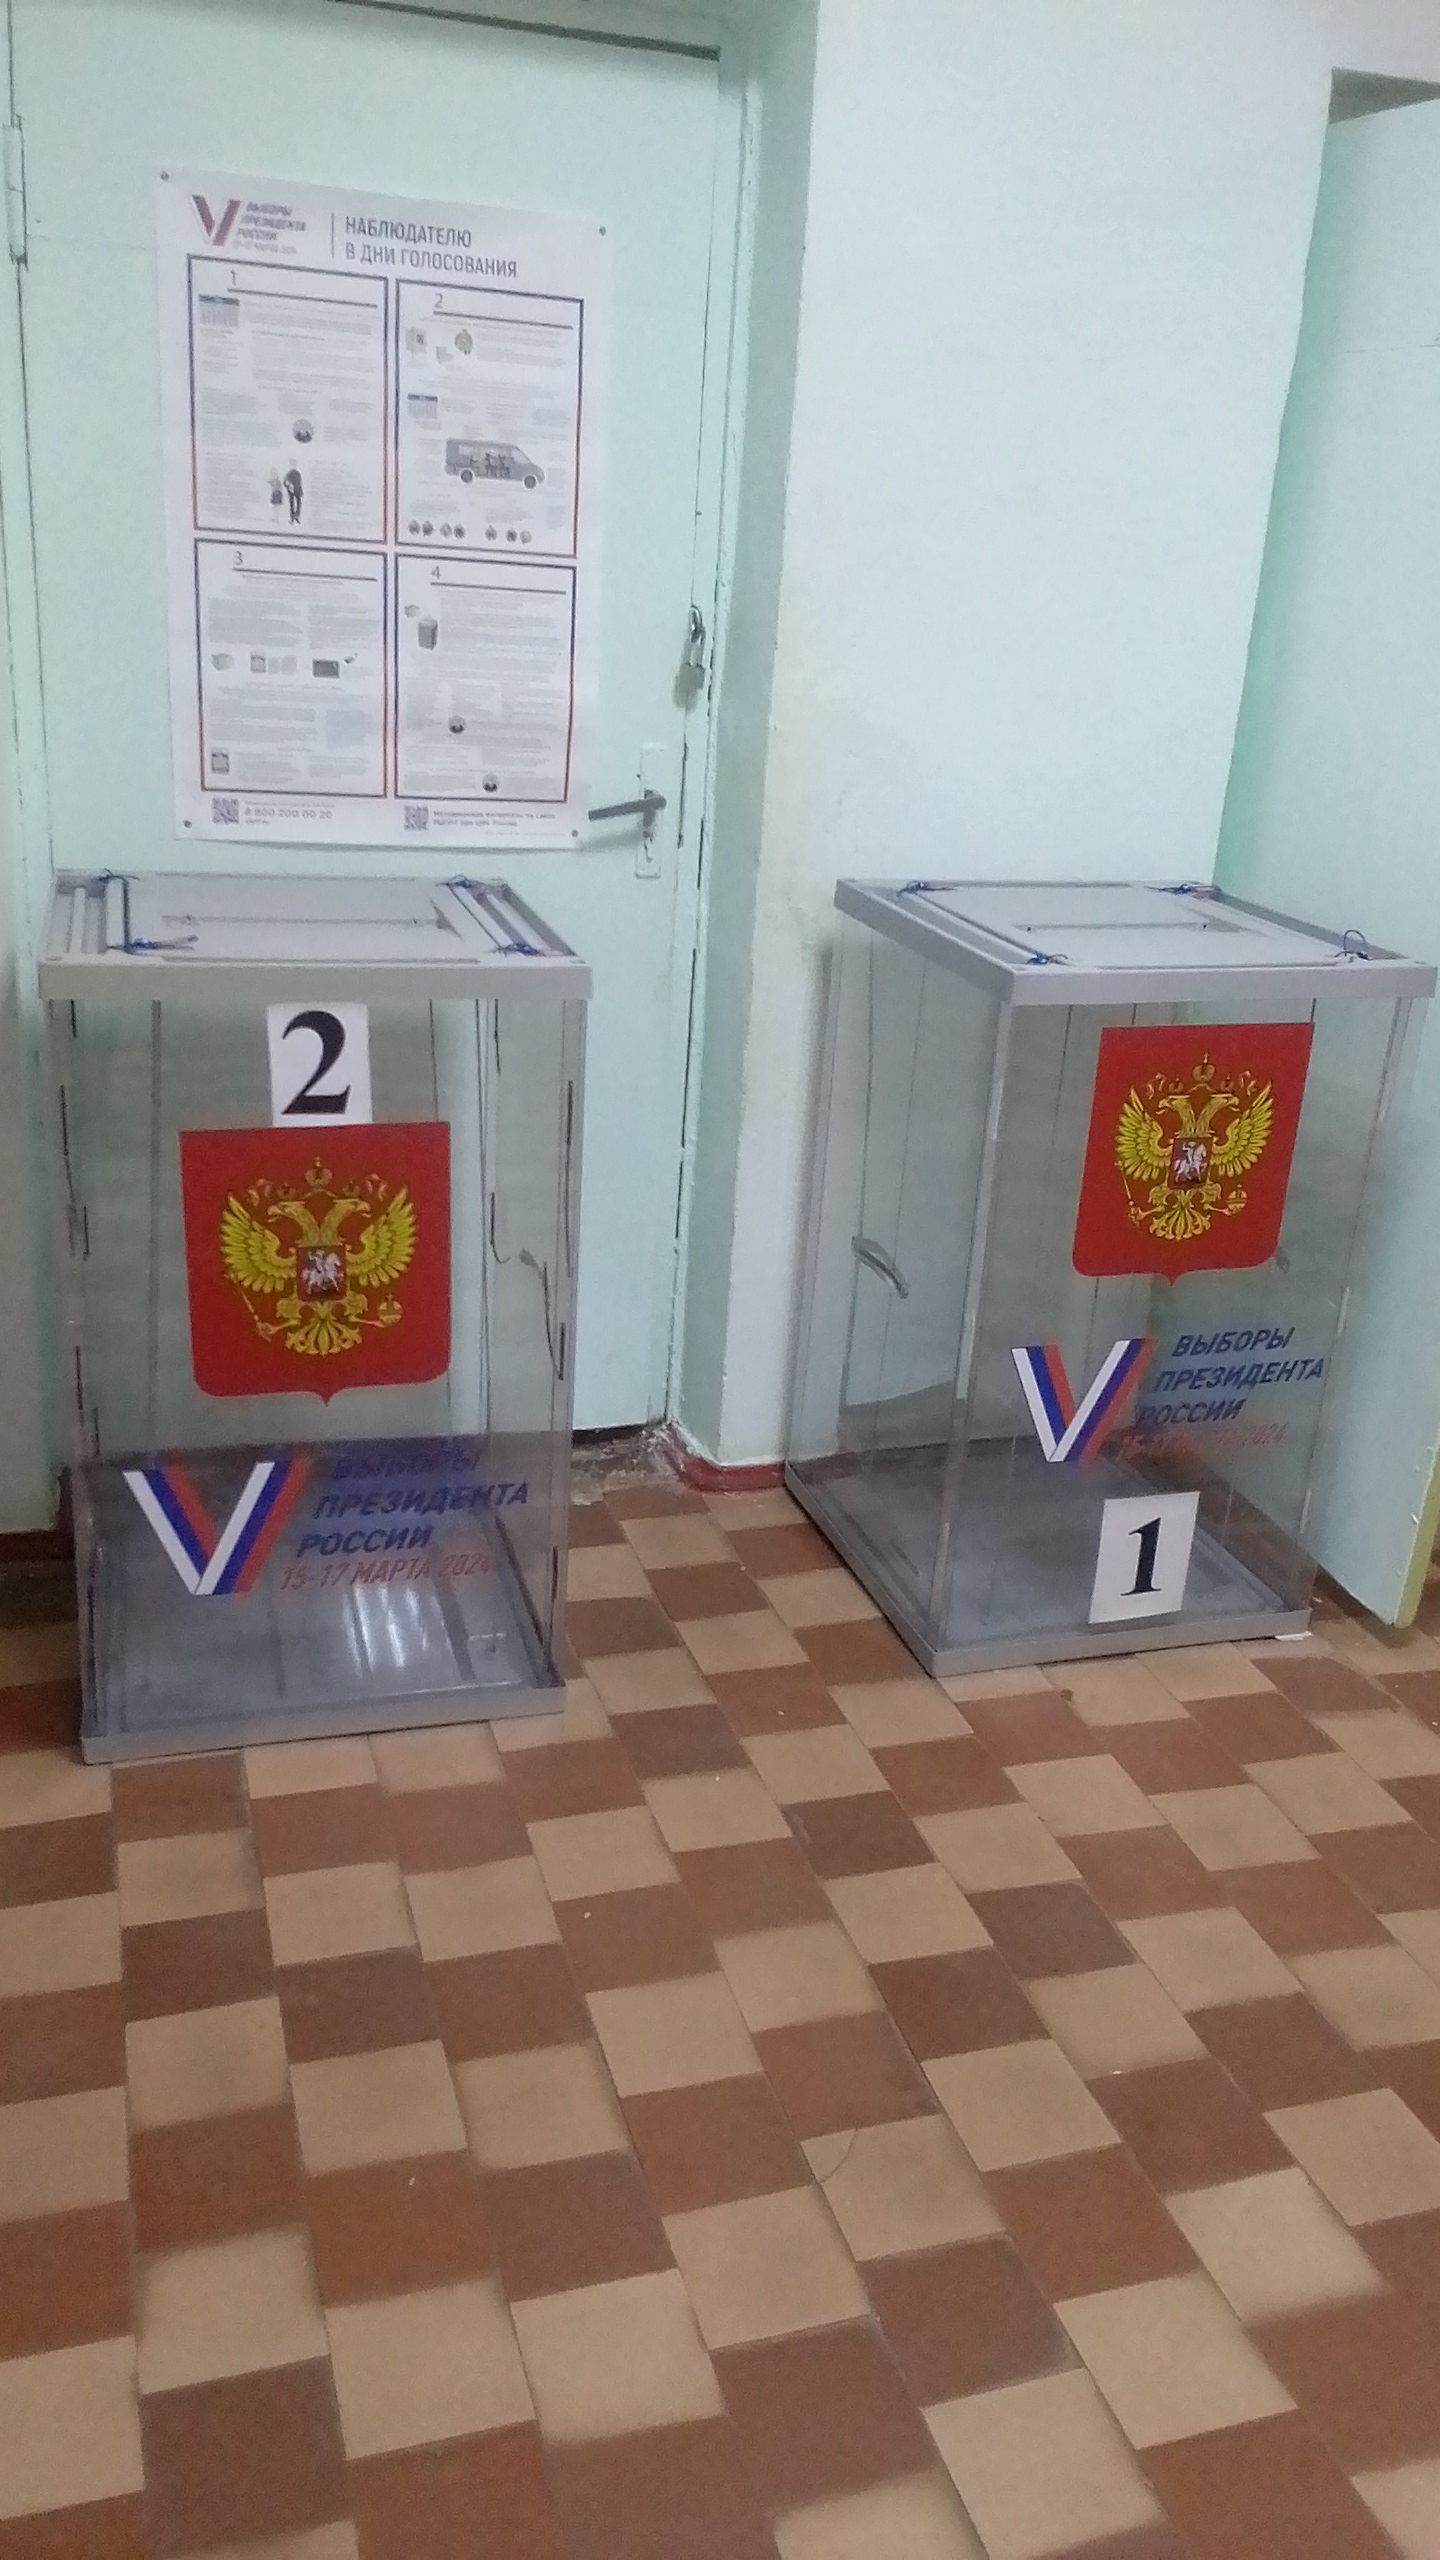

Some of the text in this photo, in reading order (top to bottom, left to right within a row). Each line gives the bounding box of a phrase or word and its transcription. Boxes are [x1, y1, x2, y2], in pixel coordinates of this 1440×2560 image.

[345, 215, 472, 248] НАБЛЮДАТЕЛЮ
[345, 241, 517, 278] В ДНИ ГОЛОСОВАНИЯ
[230, 268, 237, 287] 1
[434, 293, 443, 309] 2
[232, 550, 243, 566] 3
[430, 565, 441, 580] 4
[281, 1010, 351, 1115] 2
[1171, 1327, 1296, 1358] ВЫБОРЫ
[1152, 1358, 1326, 1393] ПРЕЗИДЕНТА
[1134, 1398, 1247, 1426] РОССИИ
[312, 1481, 529, 1520] ПРЕЗИДЕНТА
[296, 1524, 435, 1559] РОССИИ
[1120, 1517, 1162, 1597] 1
[280, 1551, 491, 1591] 15-17 МАРТА 2024
